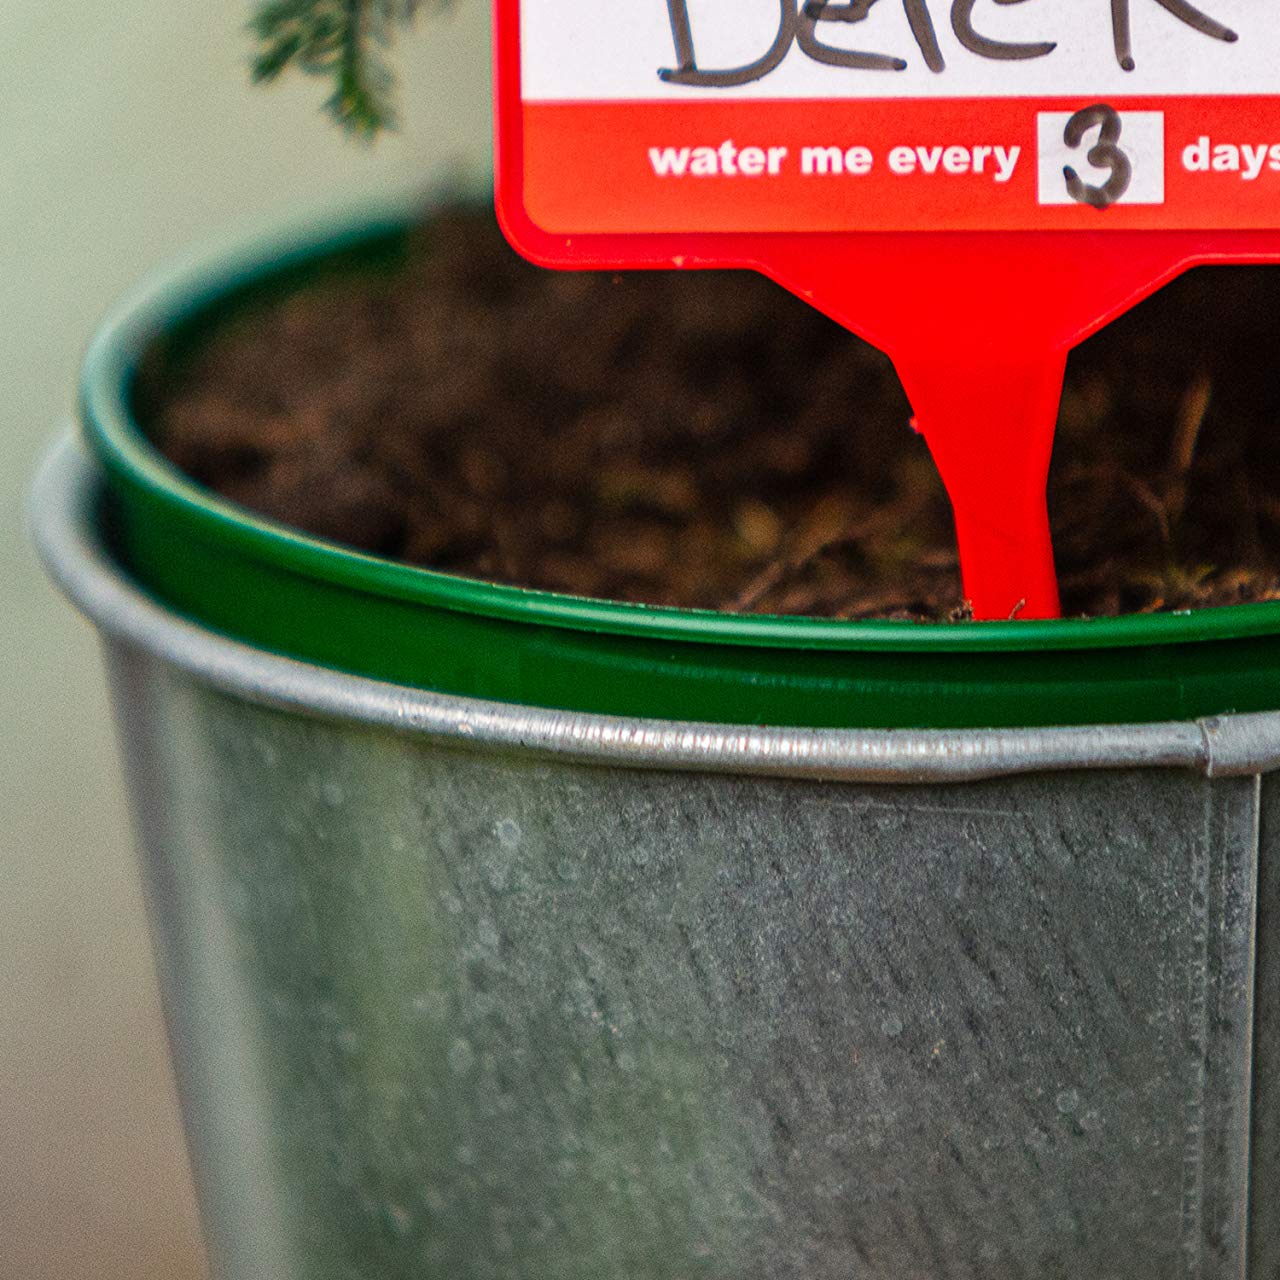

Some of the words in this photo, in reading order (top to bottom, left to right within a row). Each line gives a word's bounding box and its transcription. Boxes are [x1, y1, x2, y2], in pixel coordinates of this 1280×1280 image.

[647, 139, 788, 177] water
[800, 145, 874, 176] me
[887, 145, 1022, 183] every
[1062, 103, 1133, 208] 3
